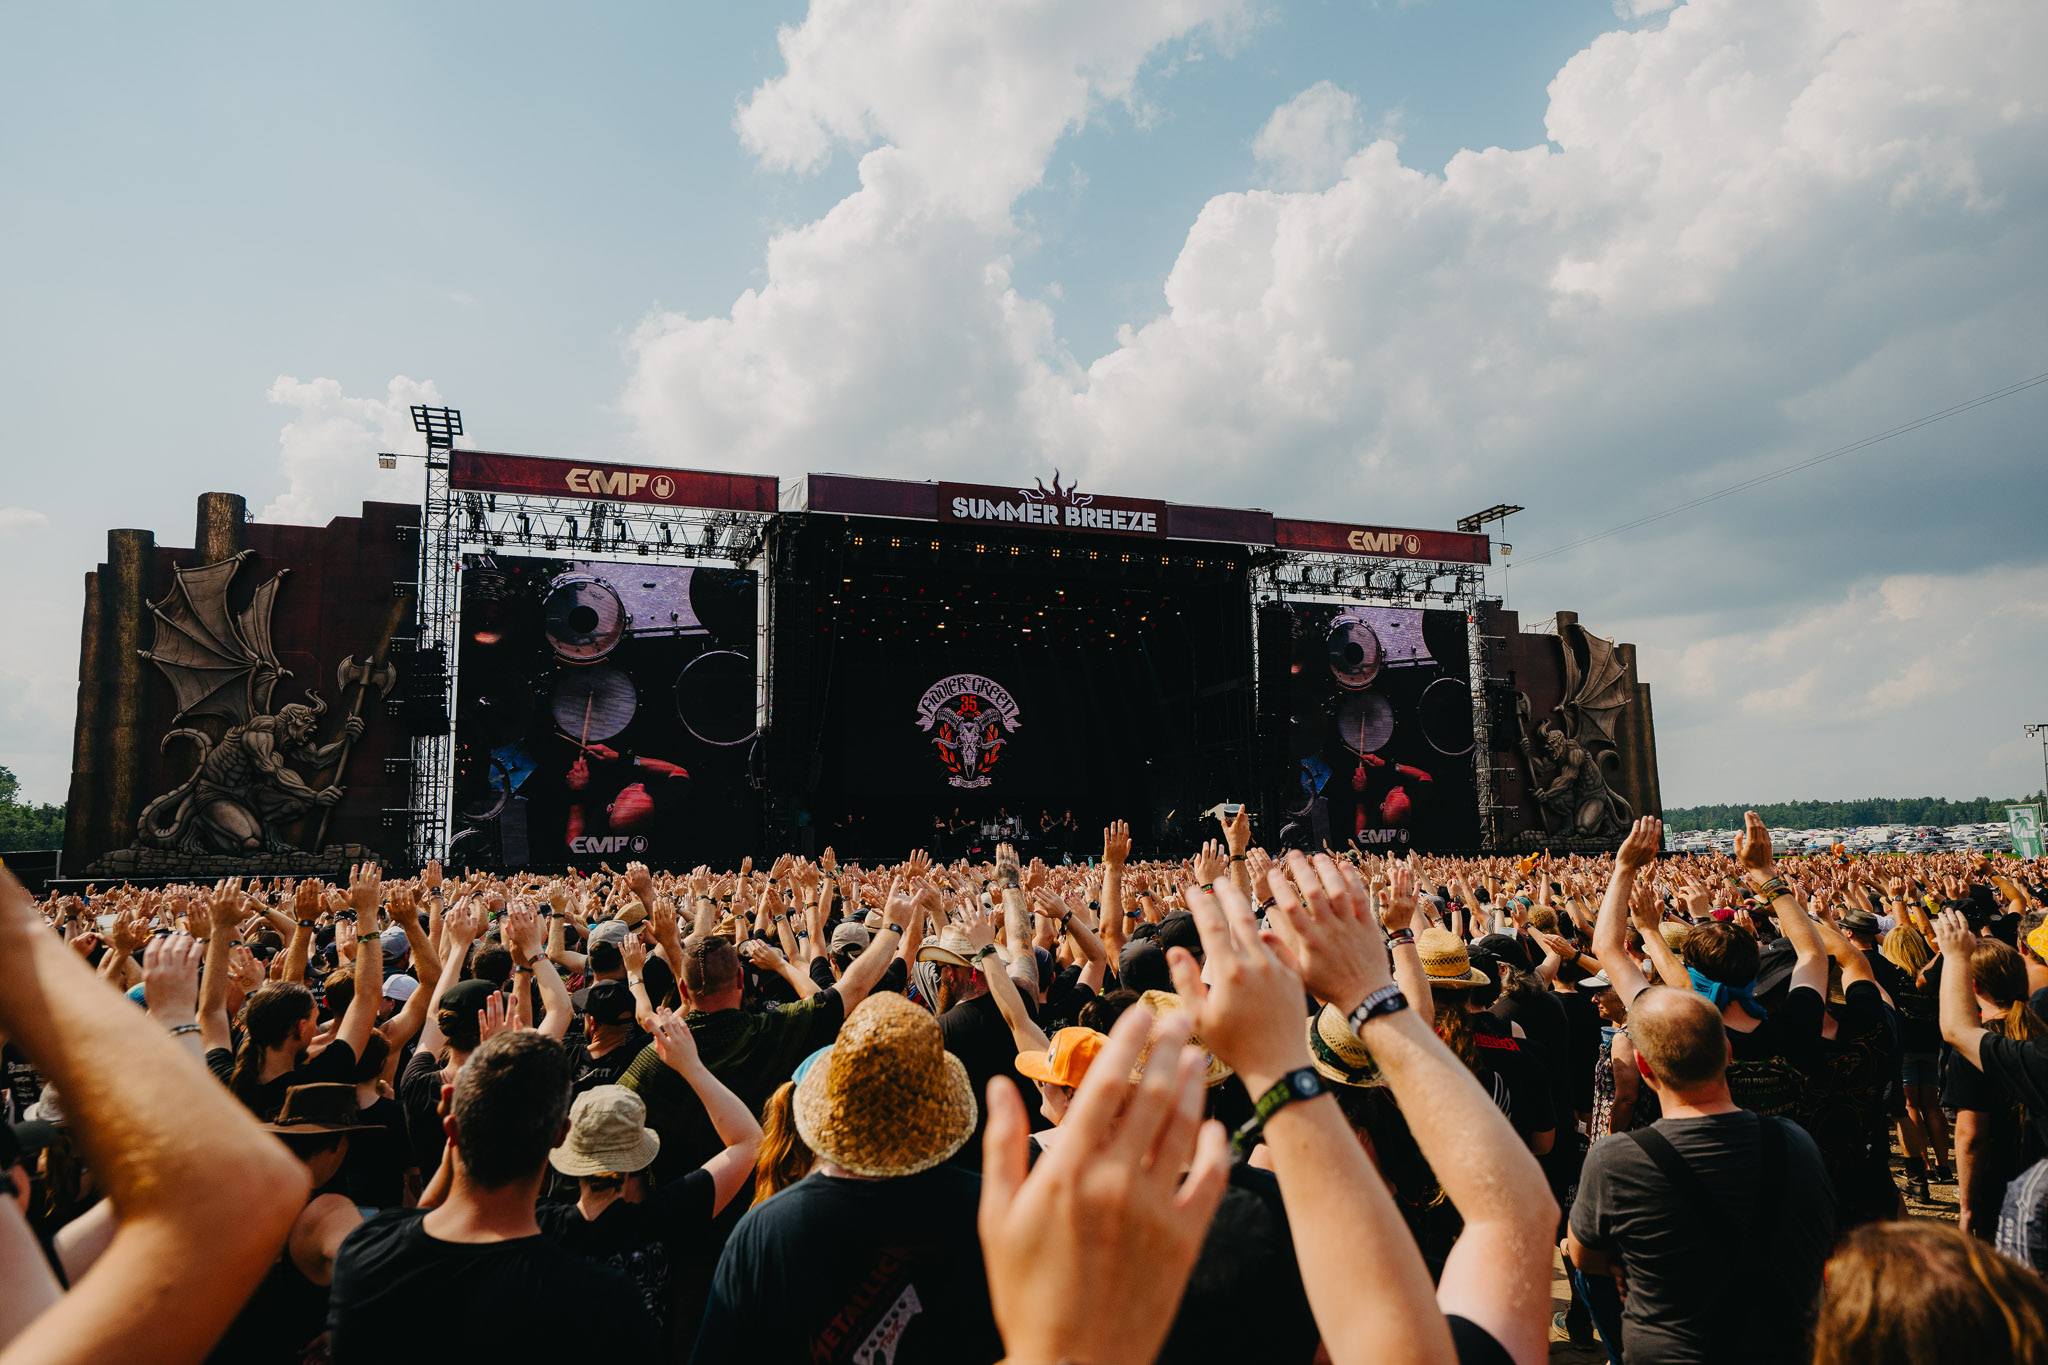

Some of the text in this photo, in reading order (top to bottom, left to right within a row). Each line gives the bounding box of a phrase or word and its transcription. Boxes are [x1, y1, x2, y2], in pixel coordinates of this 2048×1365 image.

[565, 468, 650, 496] EMP
[952, 496, 1157, 533] SUMMER BREEZE
[1347, 530, 1404, 552] EMP
[960, 695, 977, 712] 35
[972, 677, 1015, 715] GREEN
[569, 836, 630, 854] EMP
[1358, 829, 1397, 844] EMP
